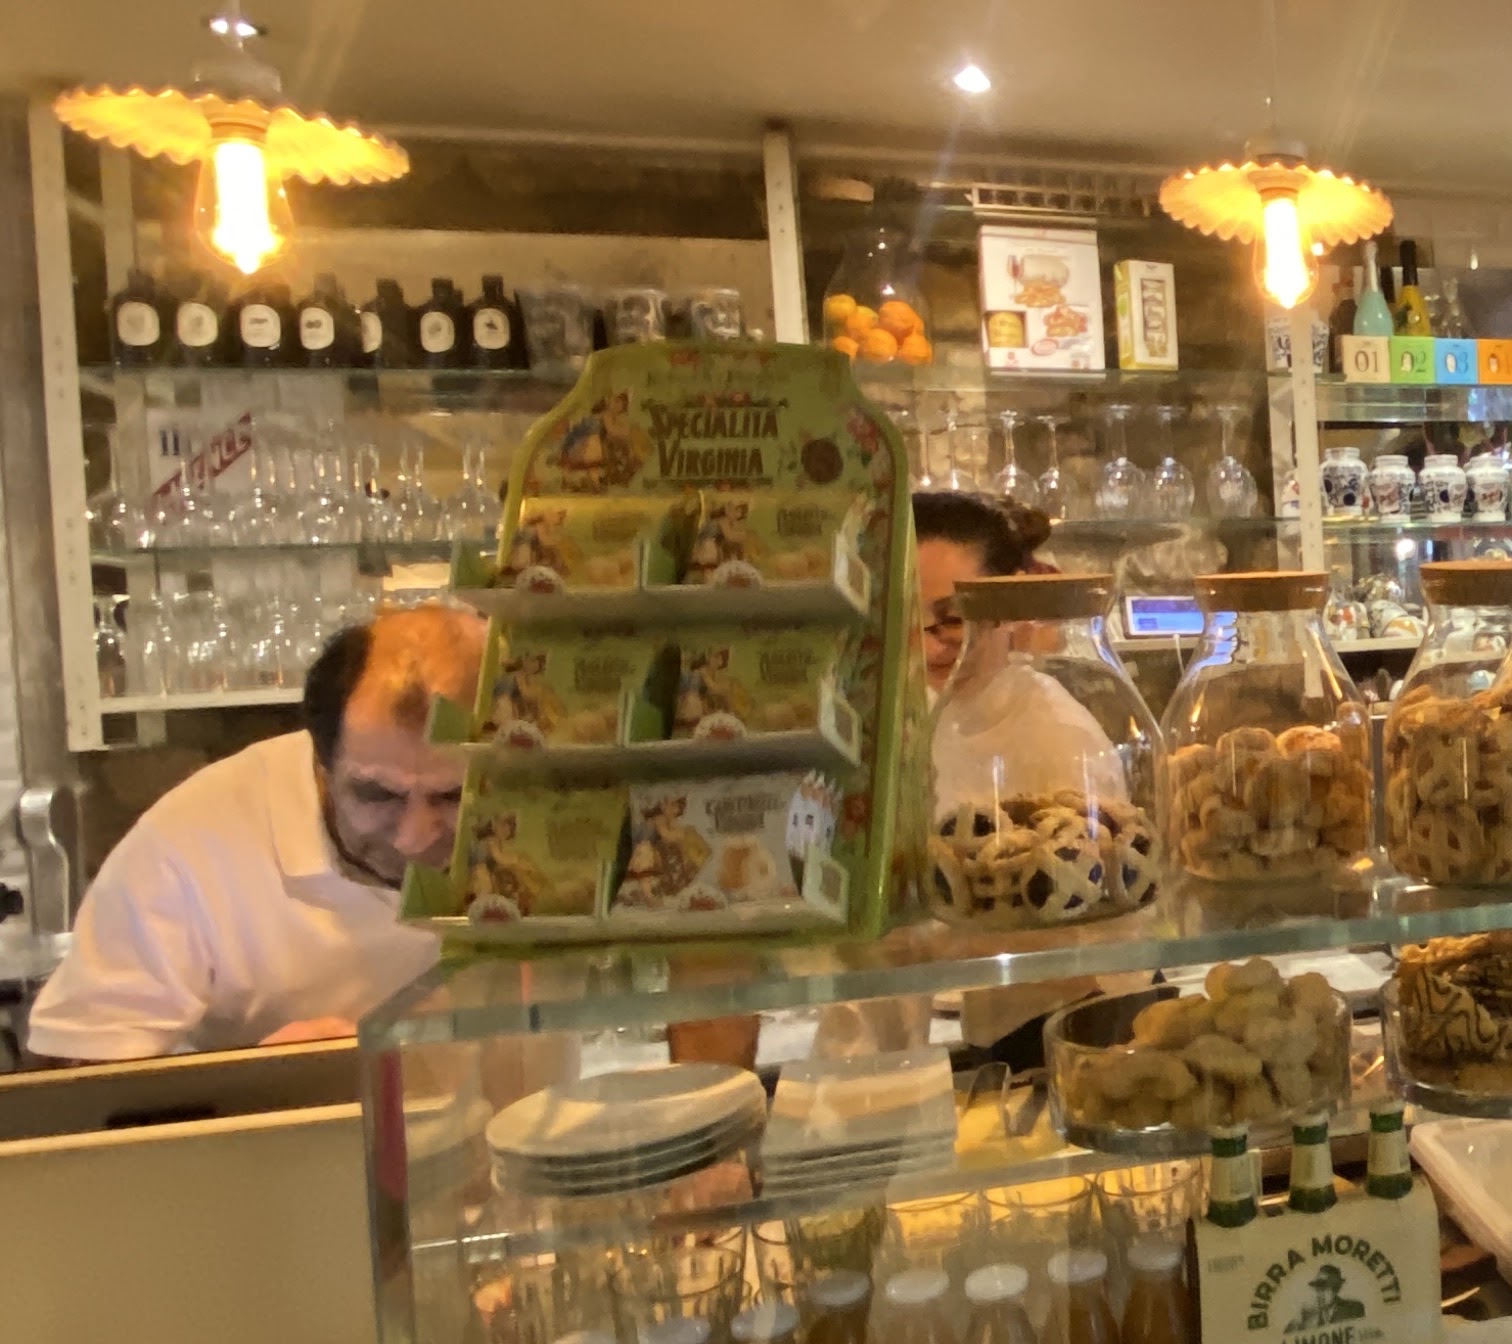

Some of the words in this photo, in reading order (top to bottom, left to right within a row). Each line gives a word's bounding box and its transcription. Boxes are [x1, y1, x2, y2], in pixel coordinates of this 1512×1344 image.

[1354, 350, 1380, 374] 01
[657, 435, 765, 477] VIRGINIA
[1247, 1248, 1306, 1331] BIRRA
[1311, 1233, 1402, 1304] MORETTI
